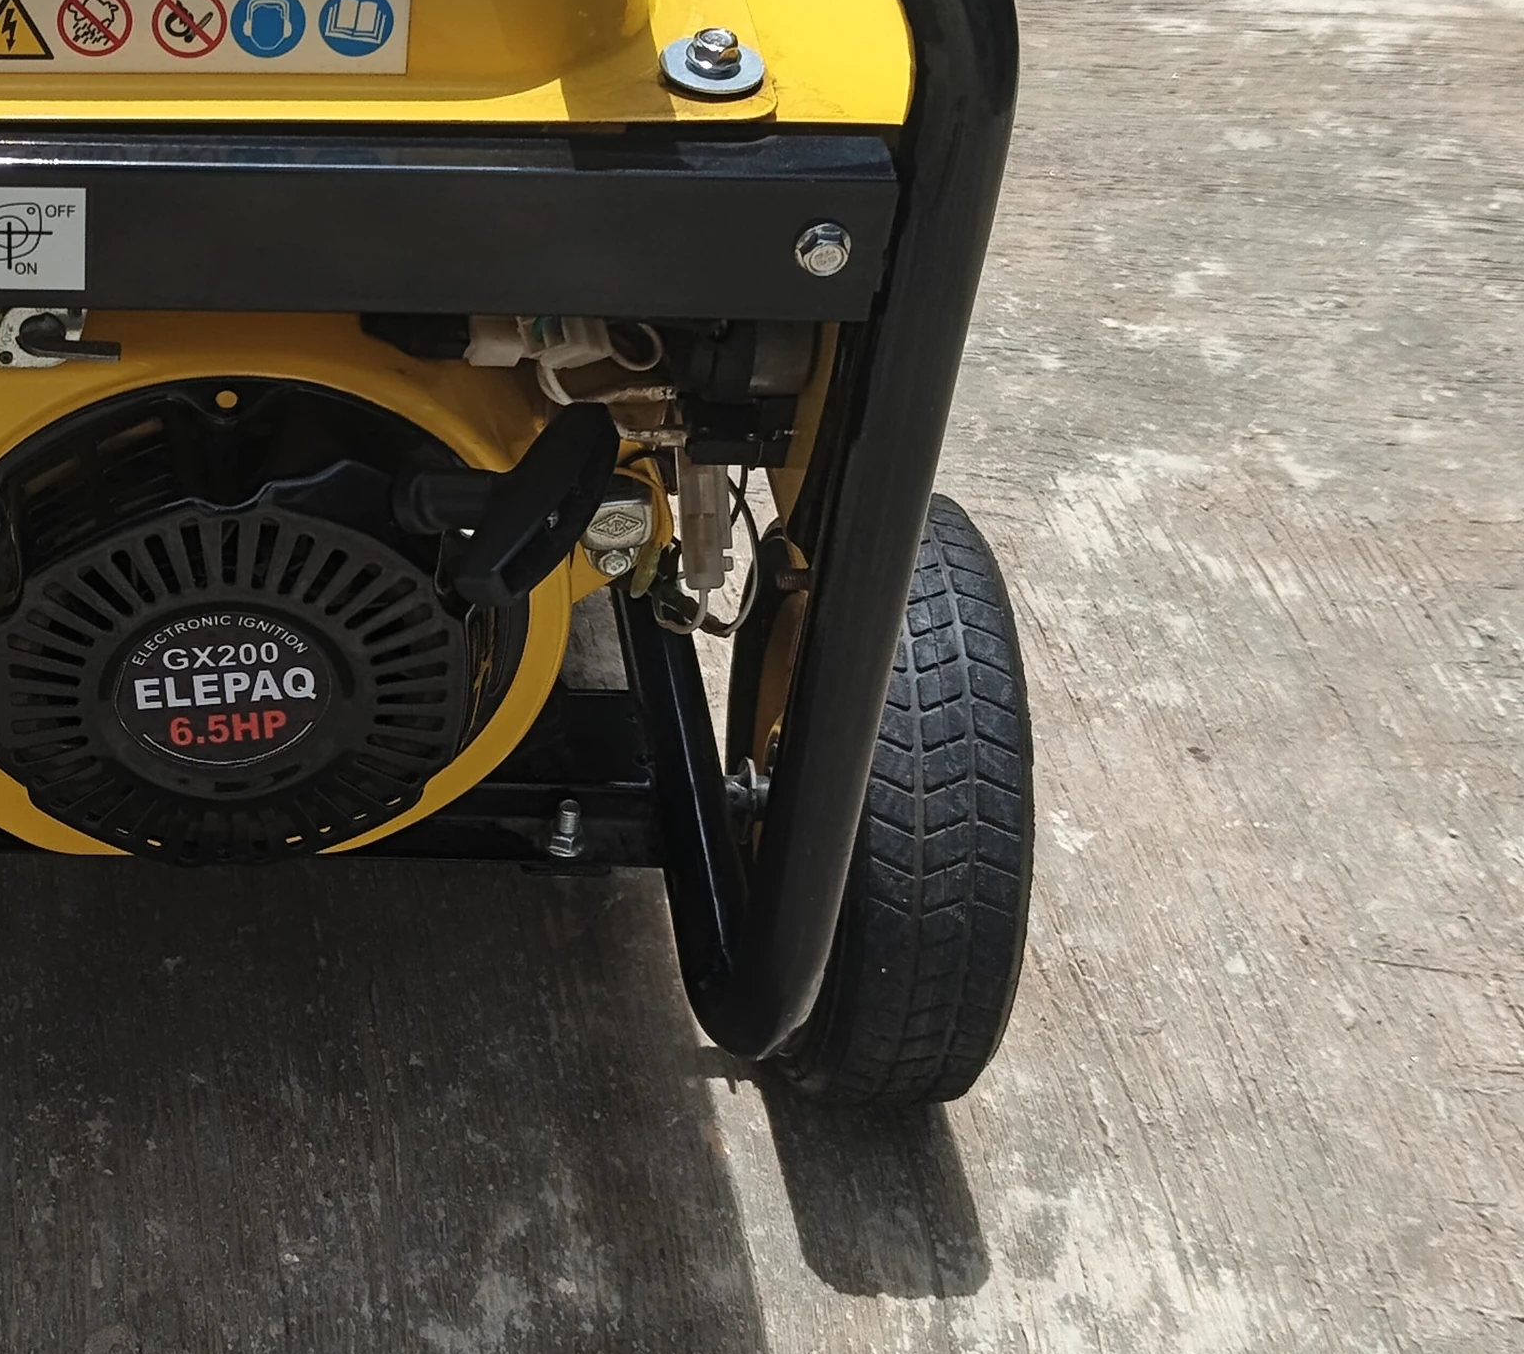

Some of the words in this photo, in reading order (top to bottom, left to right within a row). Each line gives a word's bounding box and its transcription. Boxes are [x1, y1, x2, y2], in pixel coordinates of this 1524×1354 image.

[45, 204, 76, 218] OFF
[15, 262, 37, 275] ON
[132, 615, 232, 666] ELECTRONIC
[238, 616, 308, 655] IGNITION
[162, 642, 279, 670] GX200
[133, 666, 317, 710] ELEPAQ
[169, 710, 287, 746] 6.5HP
